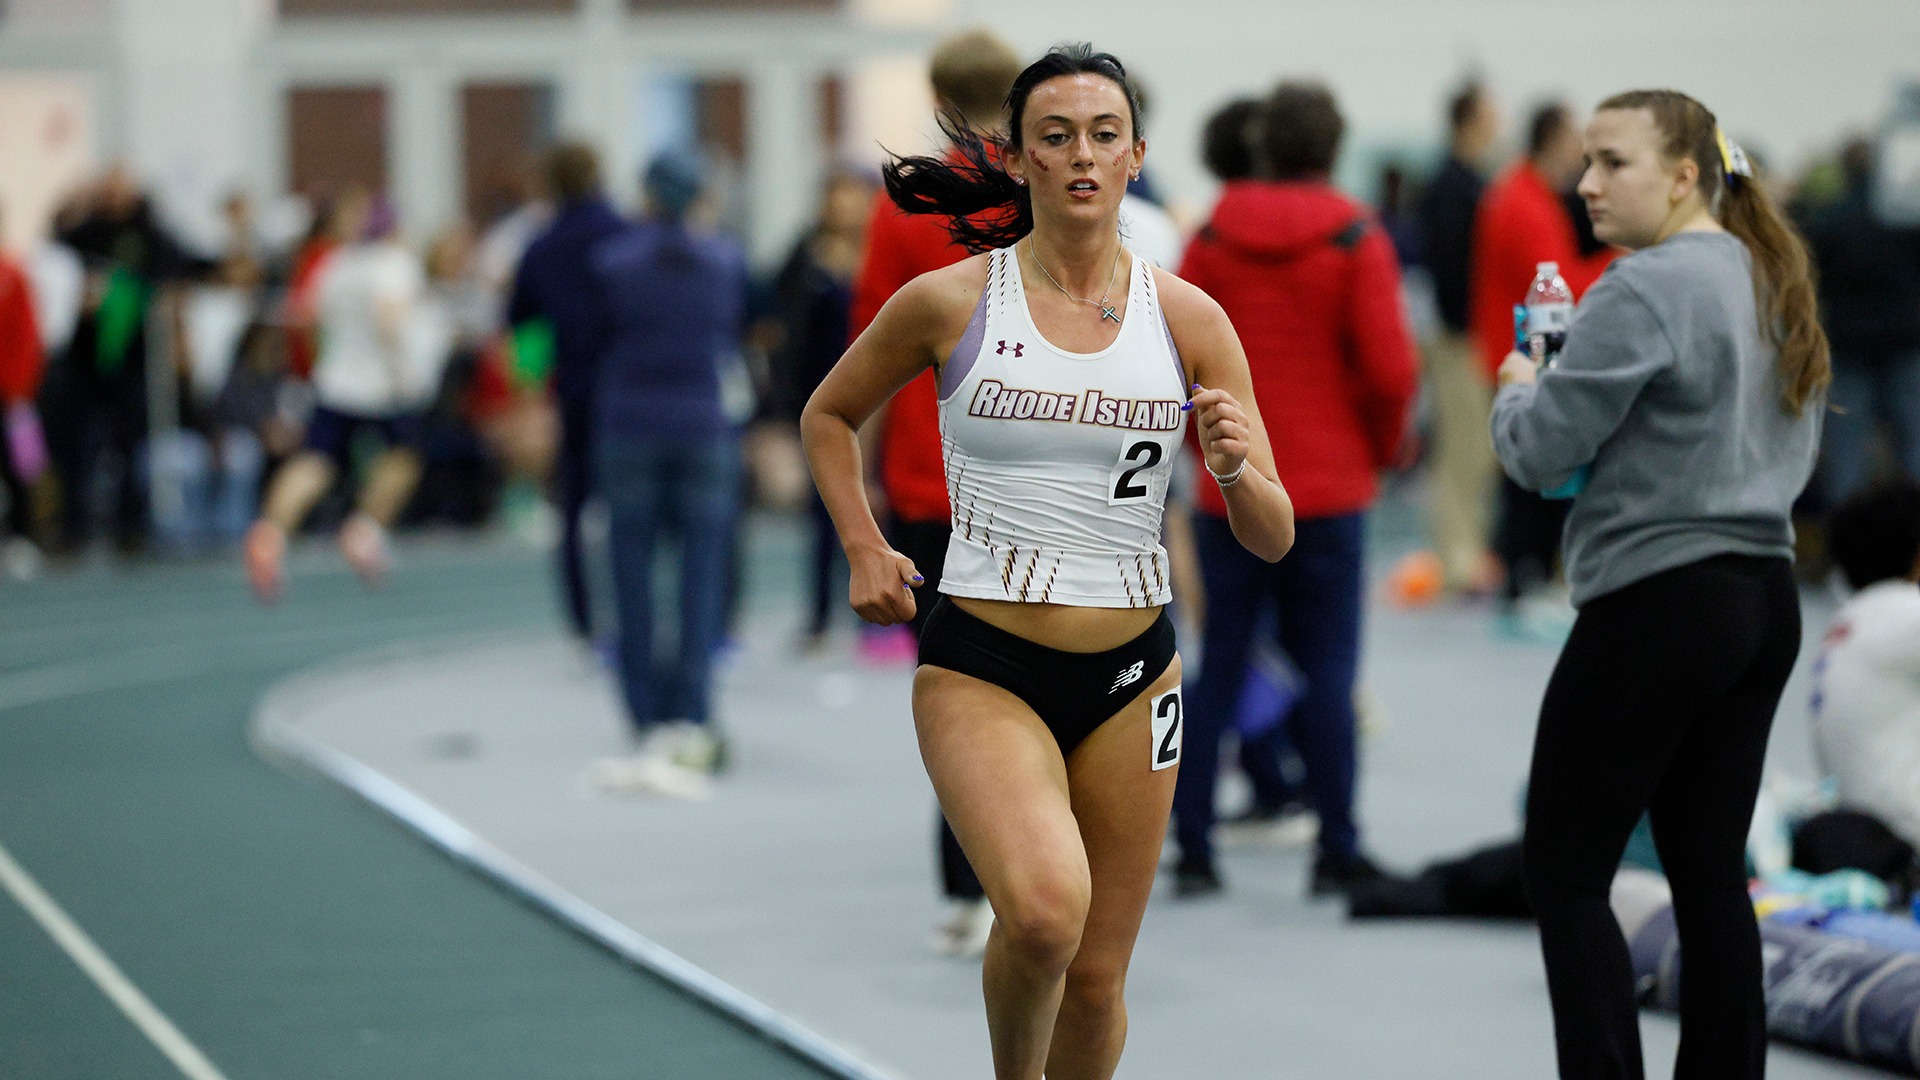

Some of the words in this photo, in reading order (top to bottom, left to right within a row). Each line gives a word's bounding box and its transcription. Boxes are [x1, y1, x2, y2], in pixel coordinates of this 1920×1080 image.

[968, 379, 1078, 421] RHODE
[1078, 389, 1182, 431] ISLAND
[1114, 441, 1162, 499] 2
[1109, 660, 1145, 694] NB
[1157, 693, 1180, 764] 2
